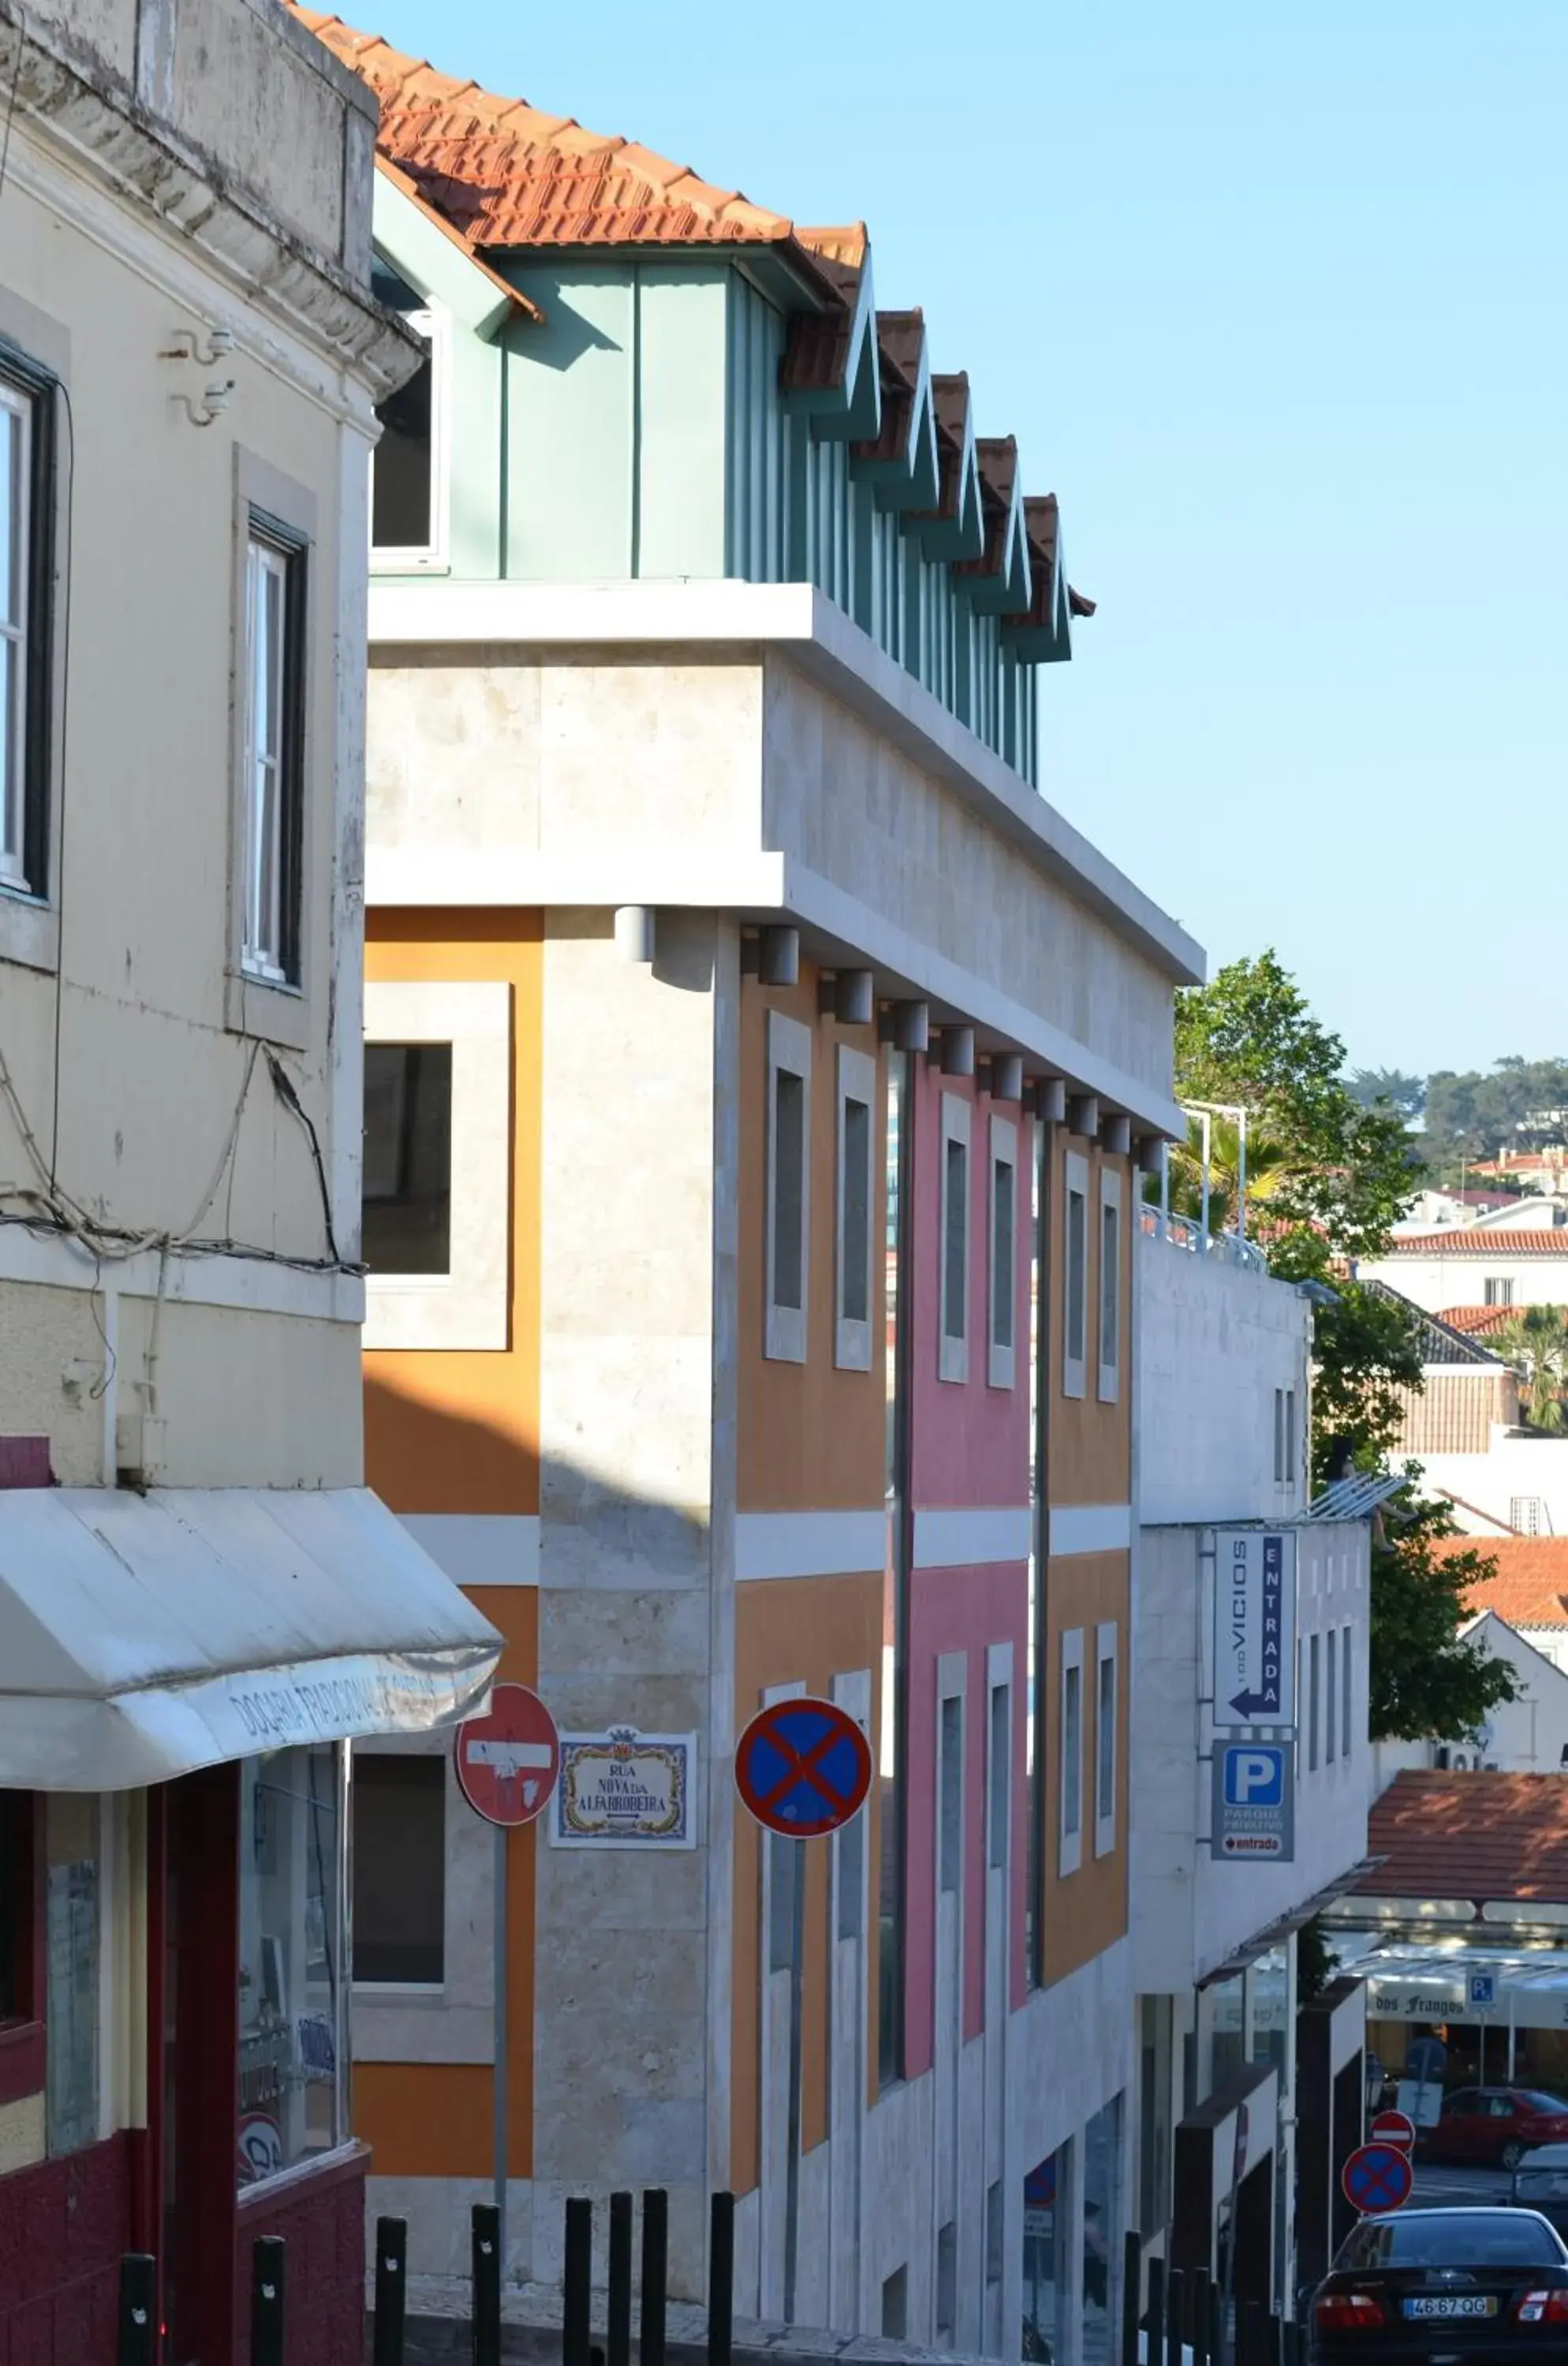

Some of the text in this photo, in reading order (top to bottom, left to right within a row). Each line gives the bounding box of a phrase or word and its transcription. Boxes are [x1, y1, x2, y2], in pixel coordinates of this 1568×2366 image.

[1264, 1549, 1279, 1702] ENTRADA
[610, 1764, 636, 1777] RUA
[1235, 1755, 1275, 1802] P
[597, 1778, 648, 1794] NOVA DA
[578, 1795, 666, 1812] ALFARROBEIRA
[1224, 1808, 1281, 1819] PARQUE
[1223, 1820, 1284, 1831] PRIVATIVO
[1236, 1836, 1279, 1850] entrada
[1376, 1995, 1399, 2012] dos
